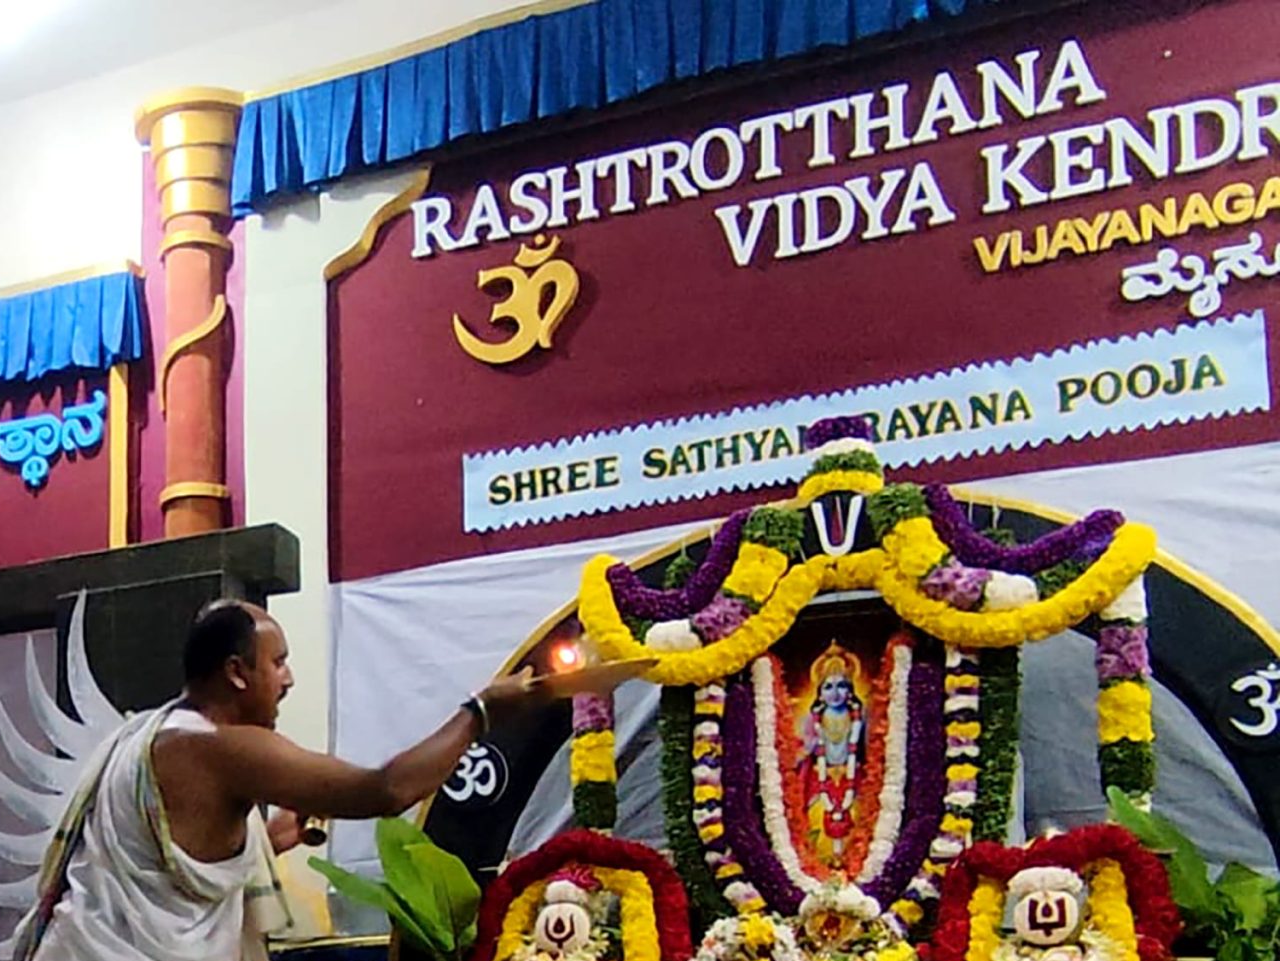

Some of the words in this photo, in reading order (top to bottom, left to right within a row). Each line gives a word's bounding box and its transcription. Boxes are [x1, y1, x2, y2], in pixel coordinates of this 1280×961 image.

[412, 40, 1107, 258] RASHTROTTHANA
[714, 161, 957, 267] VIDYA
[981, 82, 1280, 213] KENDR
[488, 456, 620, 506] SHREE
[641, 389, 1032, 479] SATHYARAYANA
[1057, 353, 1224, 413] POOJA
